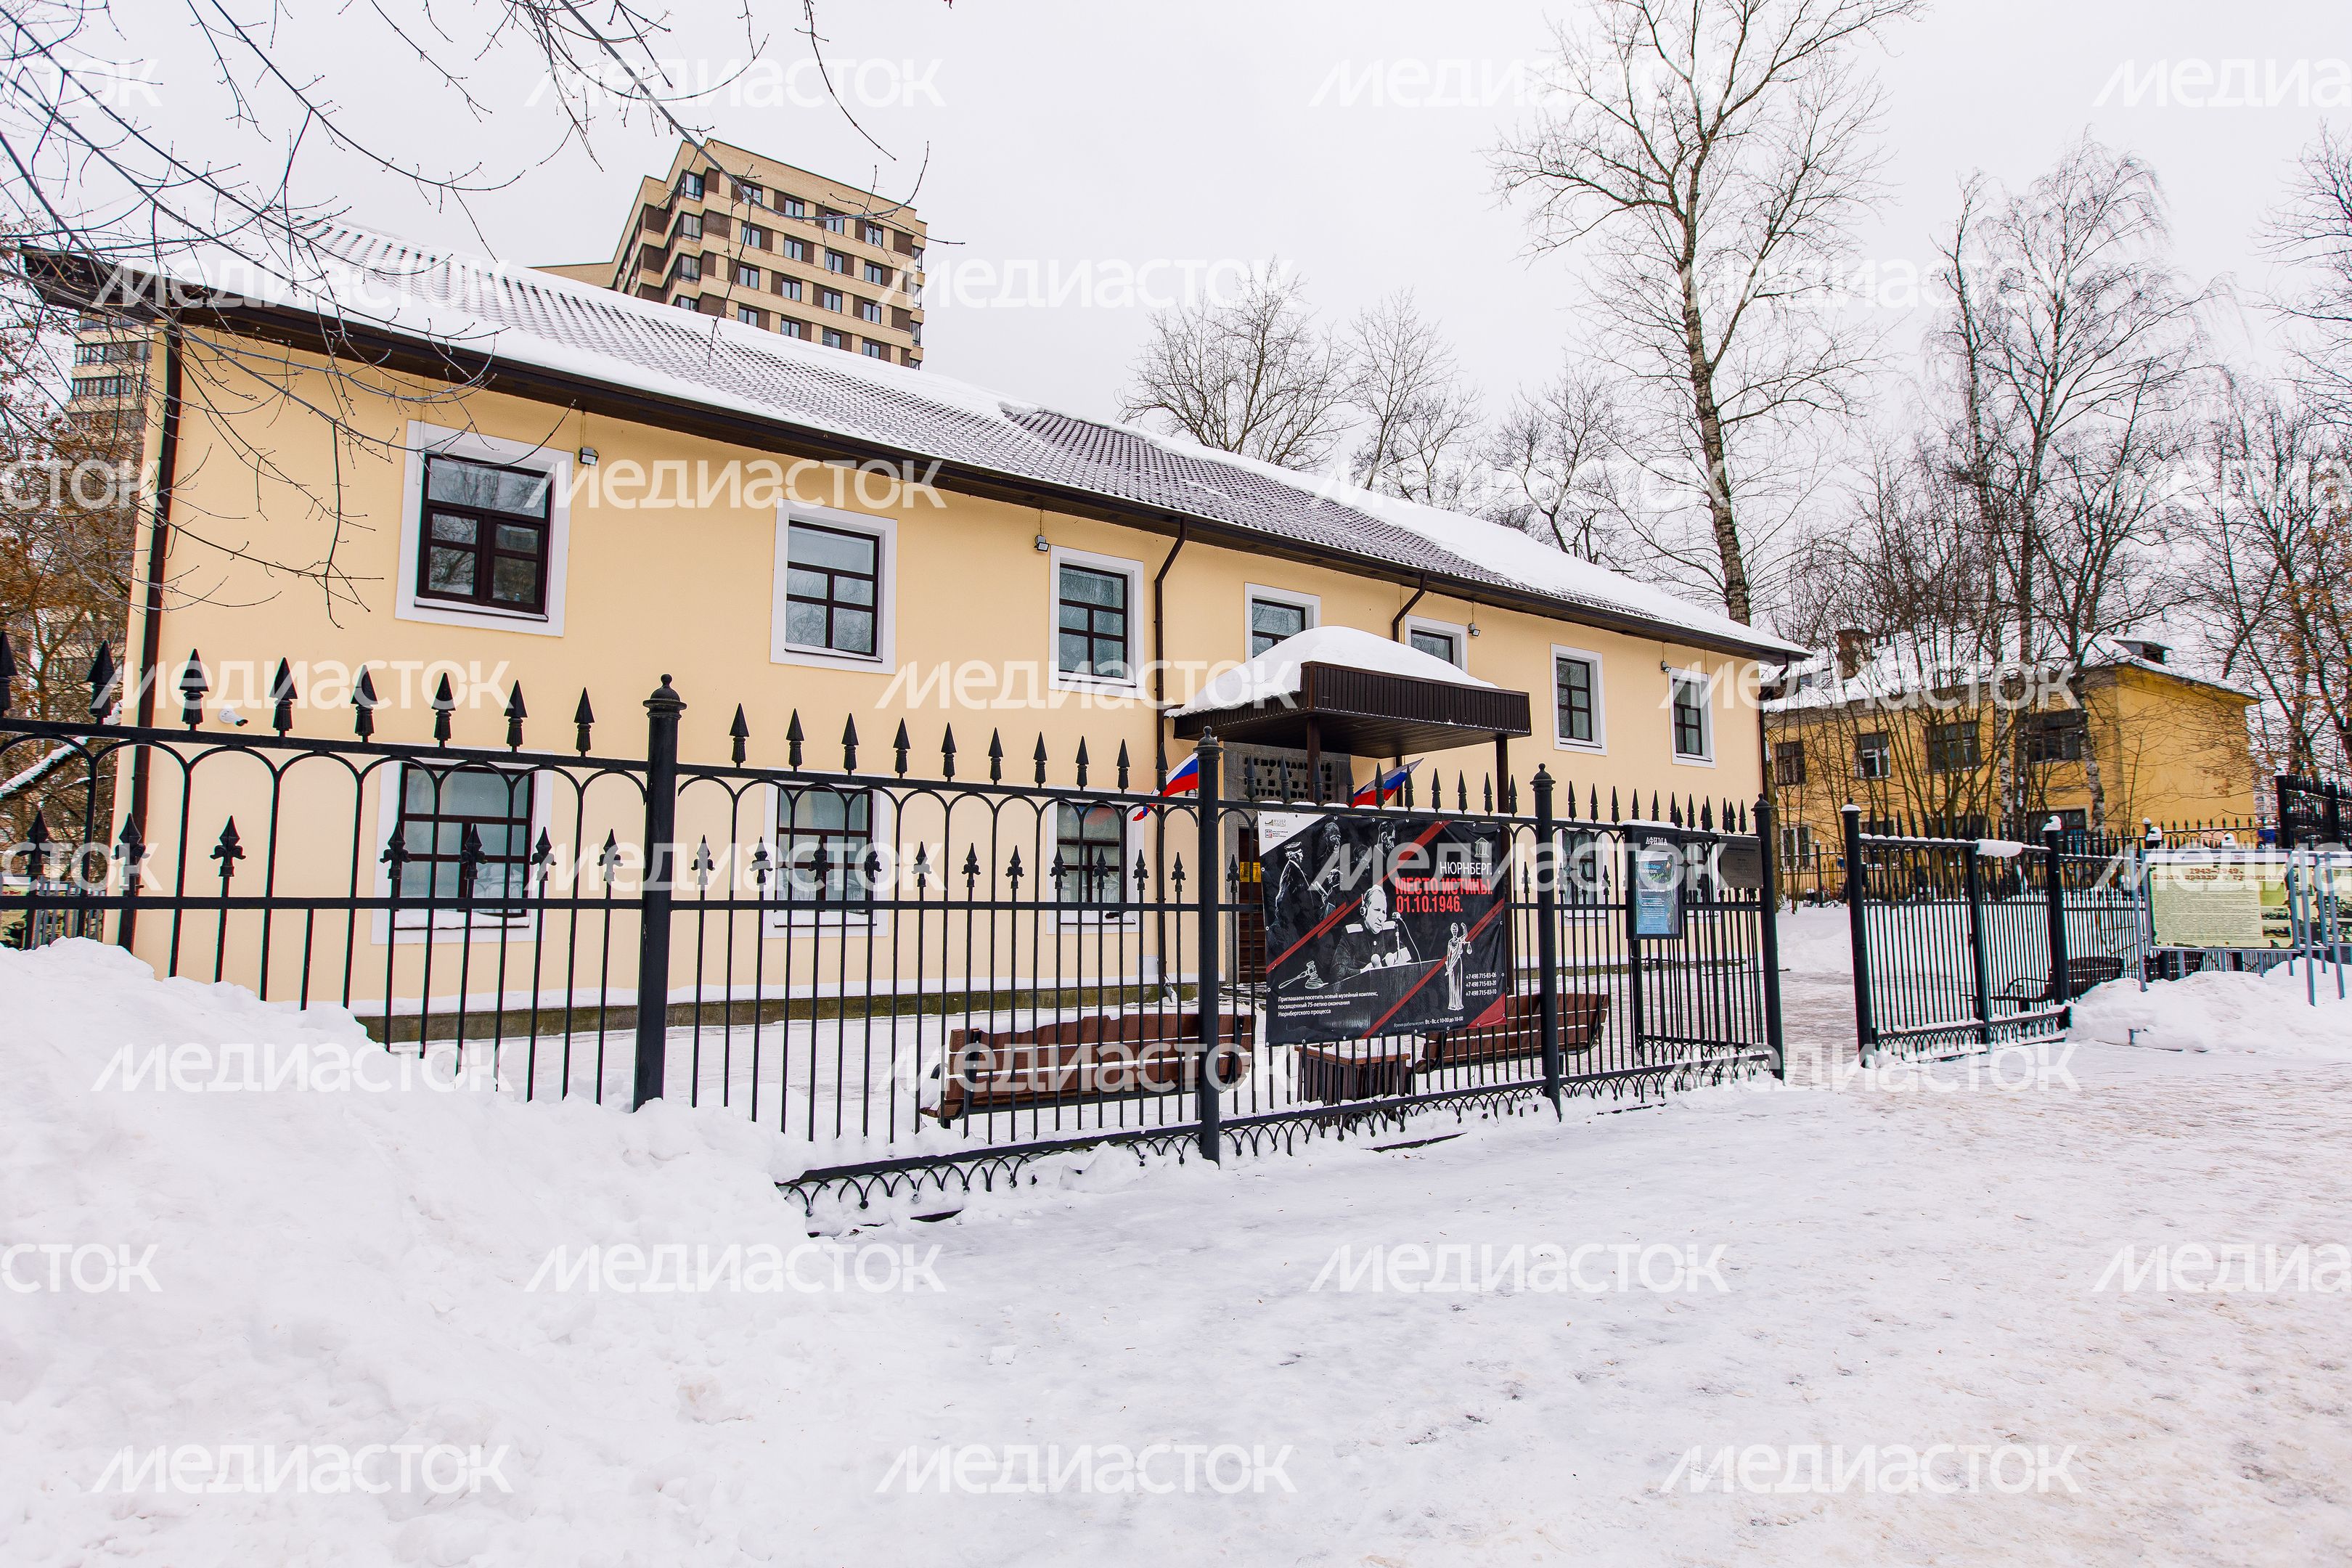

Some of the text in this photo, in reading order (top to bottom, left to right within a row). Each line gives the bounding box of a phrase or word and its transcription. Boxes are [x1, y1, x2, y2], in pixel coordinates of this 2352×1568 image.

[1646, 836, 1667, 846] АФИША
[1440, 862, 1493, 875] НЮРНБЕРГ.
[1395, 877, 1493, 895] МЕСТО ИСТИНЫ.
[1396, 895, 1463, 913] 01.10.1946.
